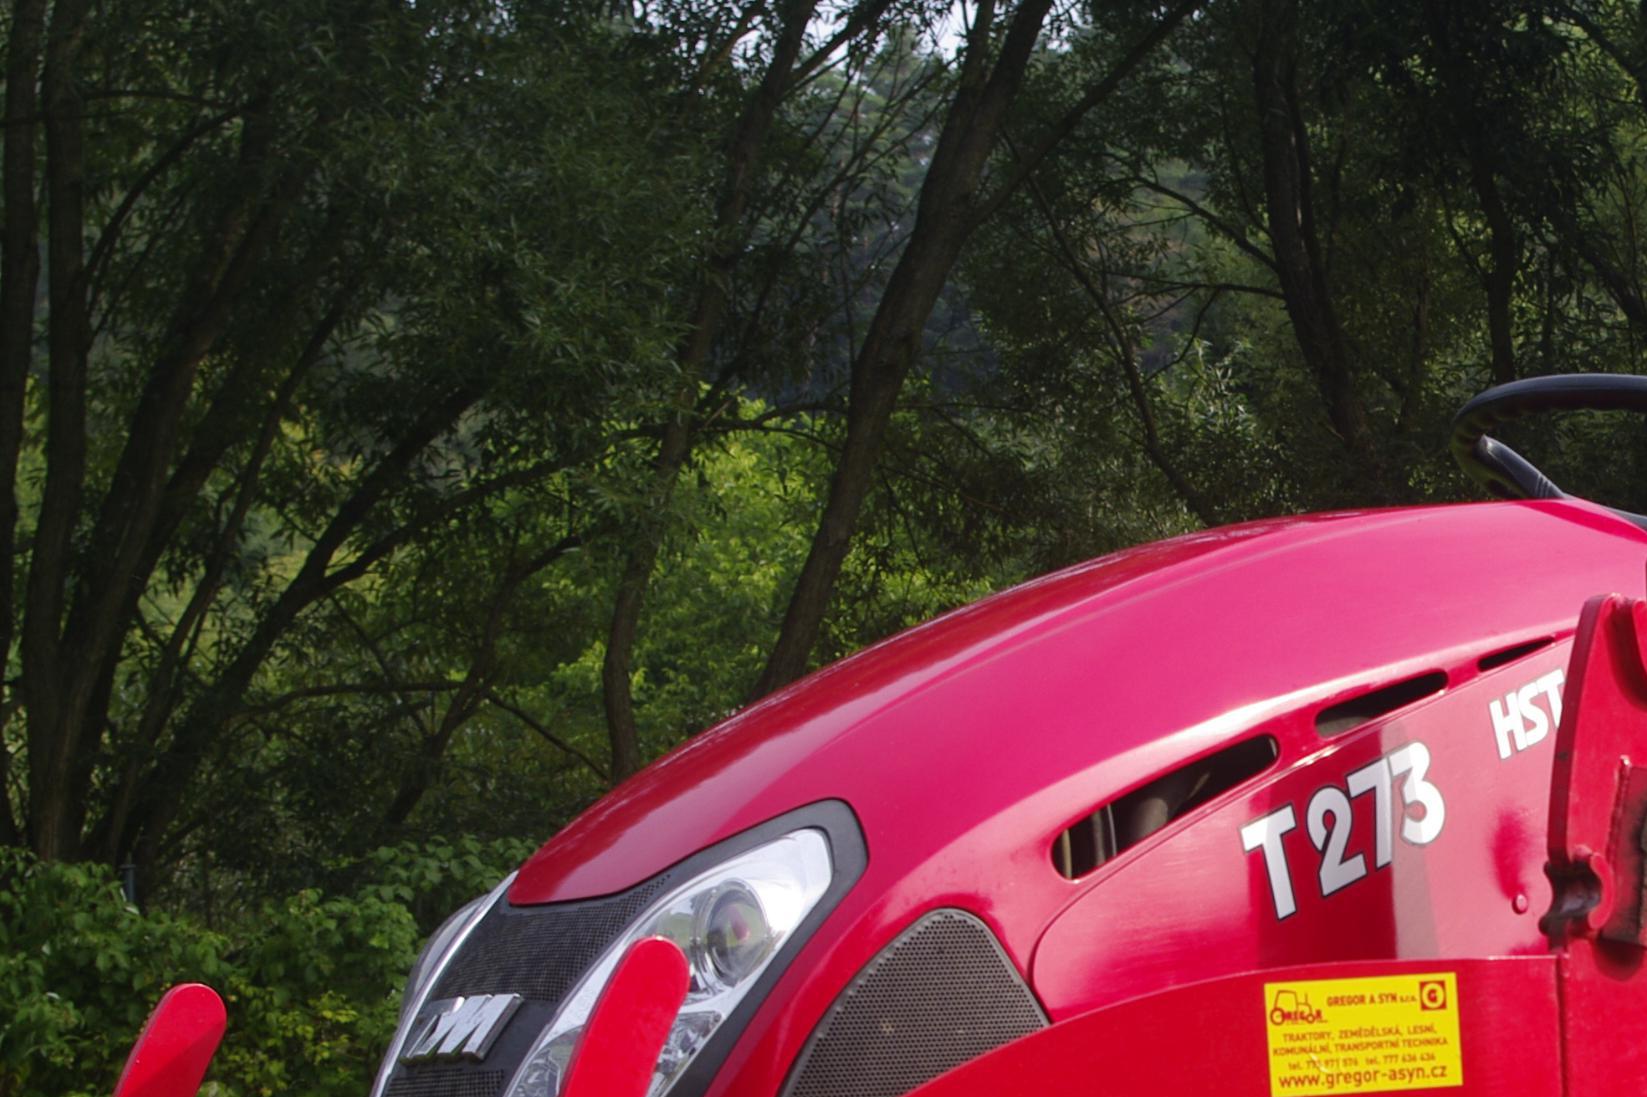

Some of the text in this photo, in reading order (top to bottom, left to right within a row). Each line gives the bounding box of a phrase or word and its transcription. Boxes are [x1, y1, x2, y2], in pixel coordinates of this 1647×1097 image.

[1488, 668, 1566, 760] HST
[1240, 741, 1446, 921] T 273
[1327, 994, 1365, 1007] GREGOR
[1369, 994, 1376, 1005] A
[1378, 992, 1398, 1004] SYN
[1402, 1037, 1448, 1049] TECHNIKA
[1279, 1065, 1447, 1089] www.gregor-asyn.cz
